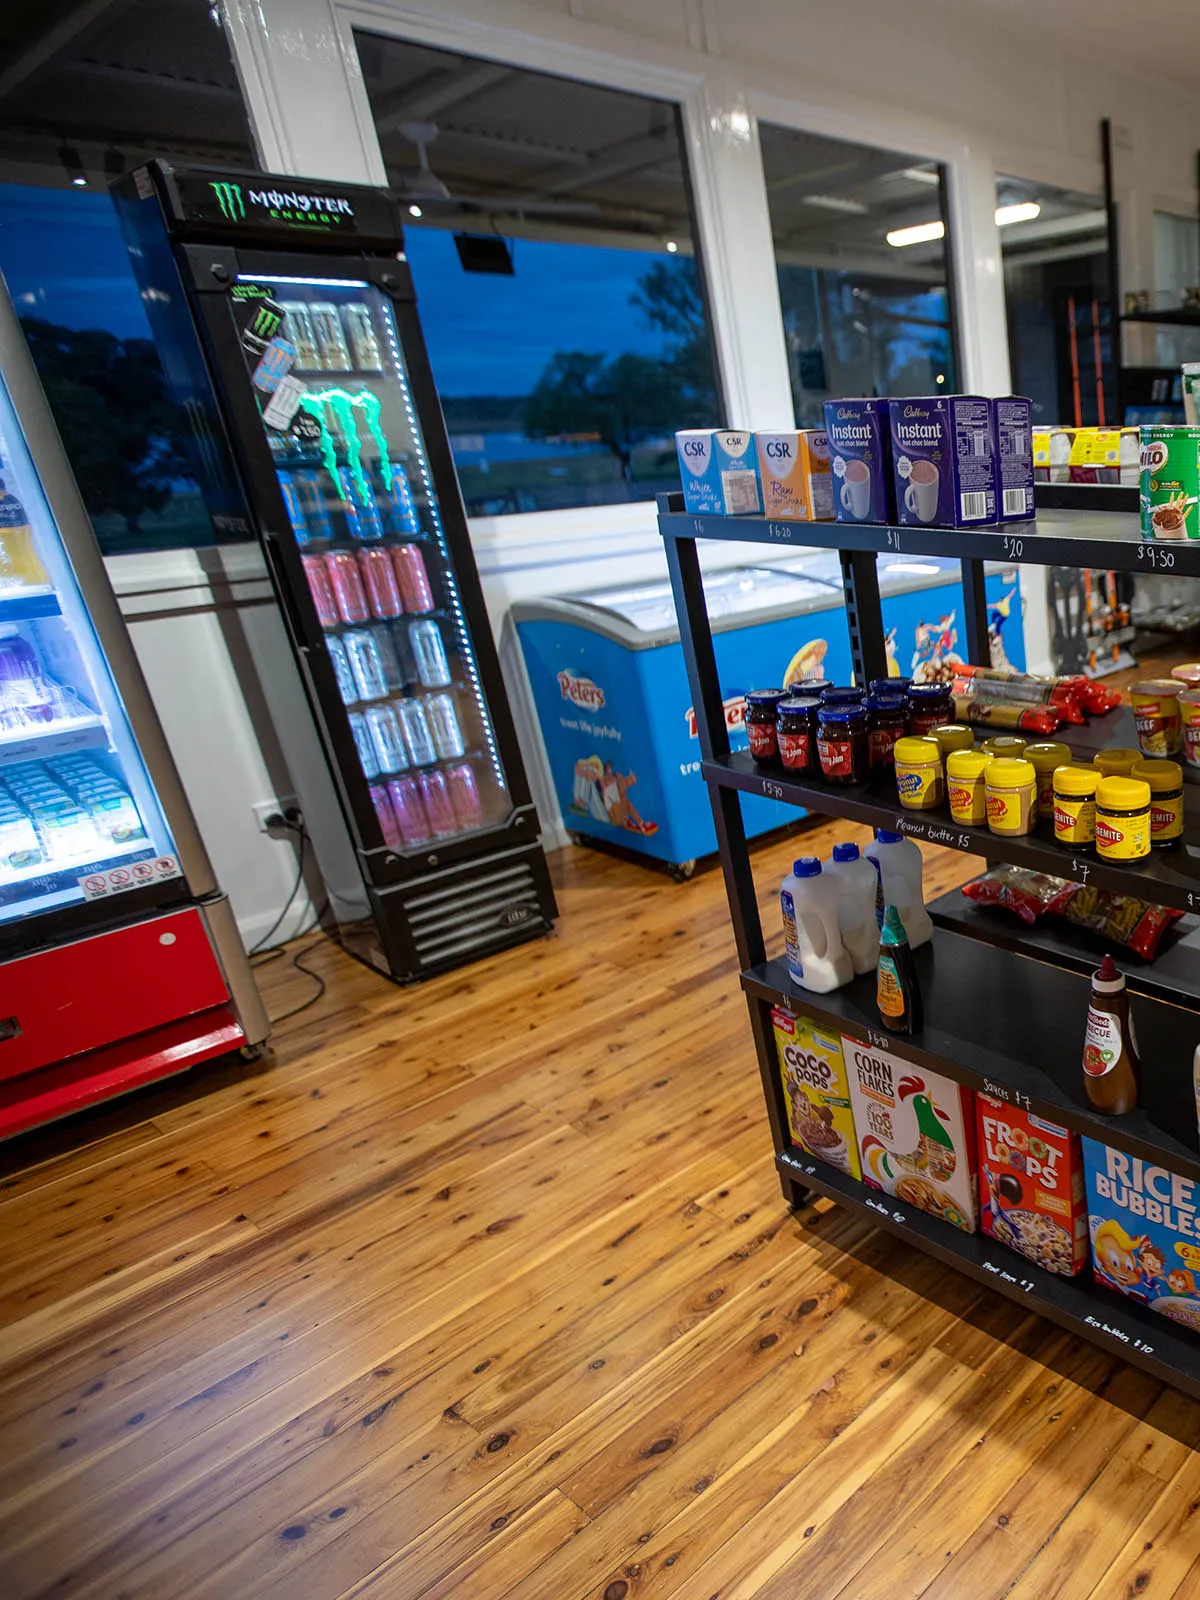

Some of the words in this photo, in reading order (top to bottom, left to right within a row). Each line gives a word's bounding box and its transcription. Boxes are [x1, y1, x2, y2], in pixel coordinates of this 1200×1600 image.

[248, 189, 354, 216] MONSTER
[269, 209, 341, 224] ENERGY
[937, 400, 942, 409] 6
[831, 423, 873, 439] Instant
[897, 422, 942, 438] Instant
[684, 442, 706, 457] CSR
[726, 437, 742, 446] CSR
[814, 438, 828, 446] CSR
[837, 439, 845, 447] hot
[902, 439, 911, 447] hot
[766, 442, 792, 458] CSR
[770, 480, 793, 495] Raw
[1004, 536, 1024, 559] $20
[557, 672, 605, 708] Peters
[895, 817, 924, 833] Peanut
[927, 825, 954, 842] butter
[854, 1051, 893, 1083] CORN
[857, 1069, 895, 1098] FLAKES
[983, 1078, 1009, 1101] Sauces
[982, 1115, 1064, 1169] FROOT
[985, 1139, 1059, 1190] LOOPS
[1104, 1146, 1197, 1214] RICE
[1180, 1246, 1190, 1258] 6
